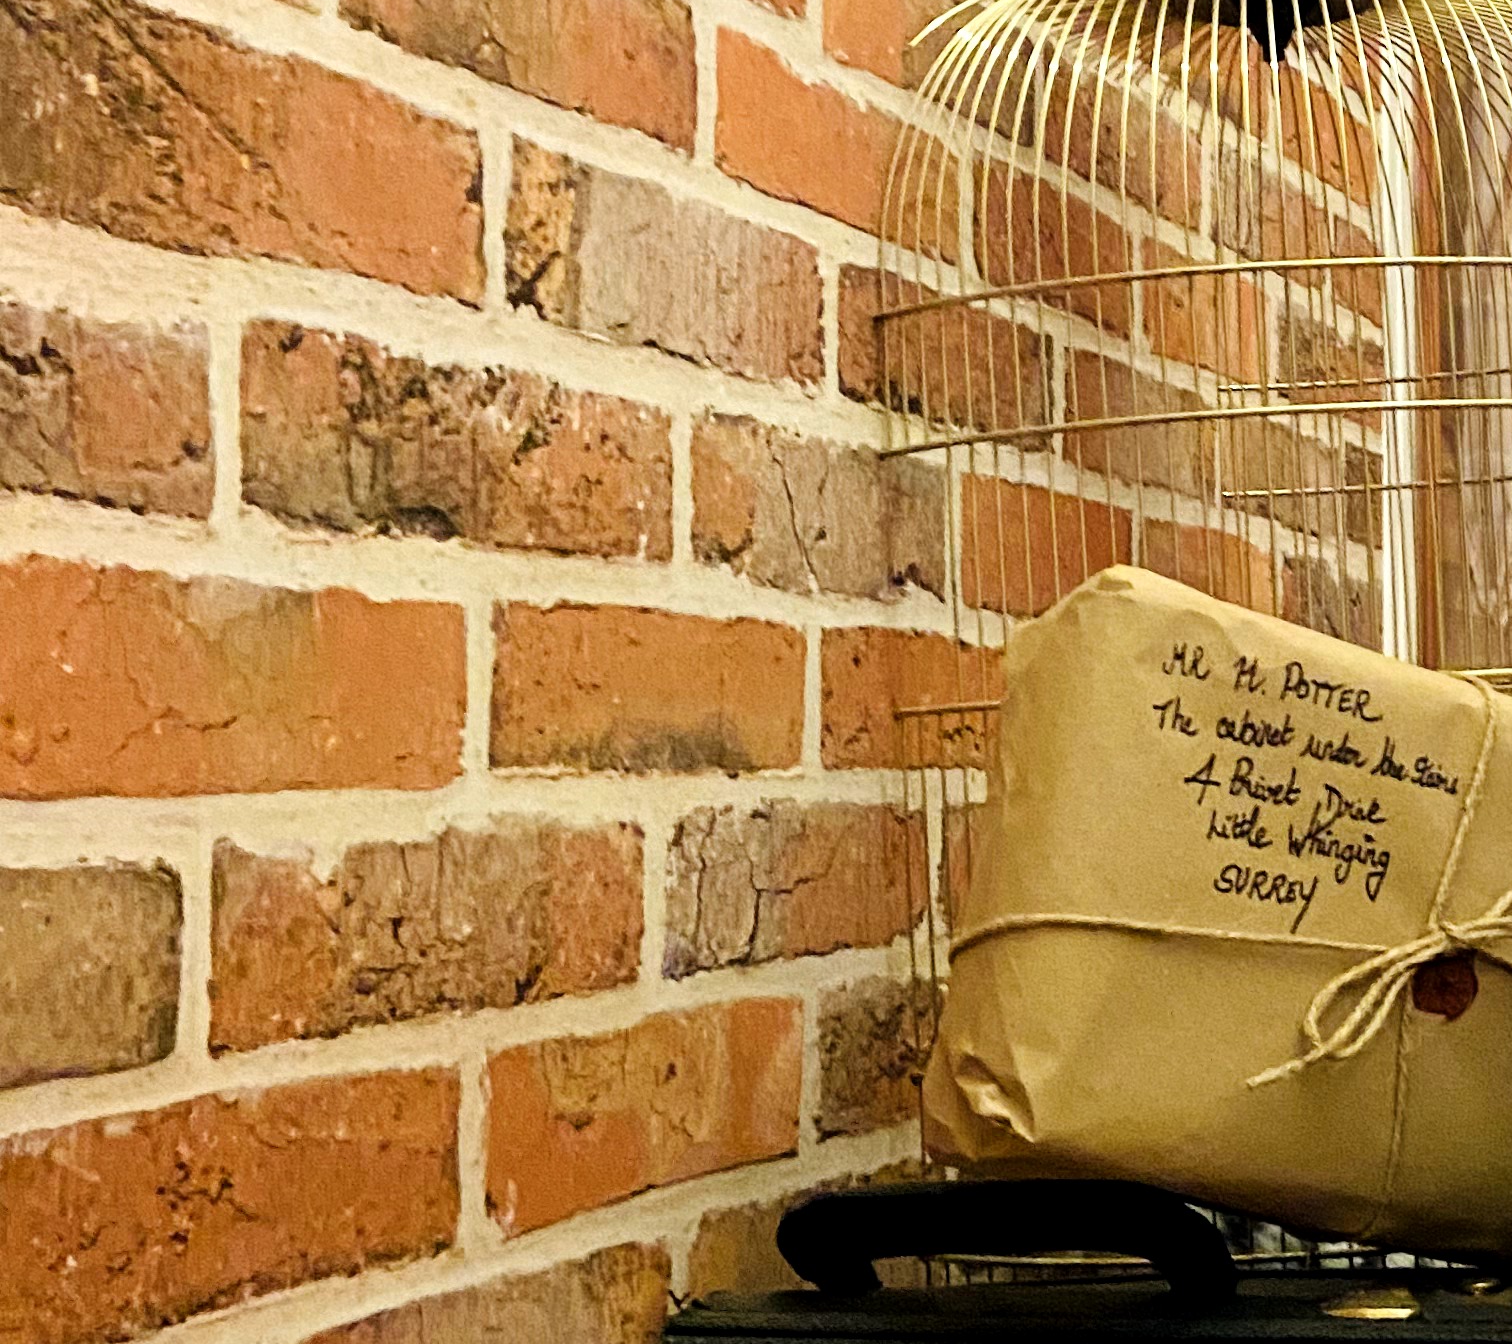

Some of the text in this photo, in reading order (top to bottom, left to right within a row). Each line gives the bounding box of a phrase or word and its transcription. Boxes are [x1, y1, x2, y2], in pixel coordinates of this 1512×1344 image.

[1153, 695, 1199, 737] The
[1163, 642, 1383, 724] MR H. POTTER
[1183, 752, 1388, 825] 4 Privet Drive
[1206, 801, 1390, 903] Little Whinging
[1213, 863, 1319, 935] SURREY
